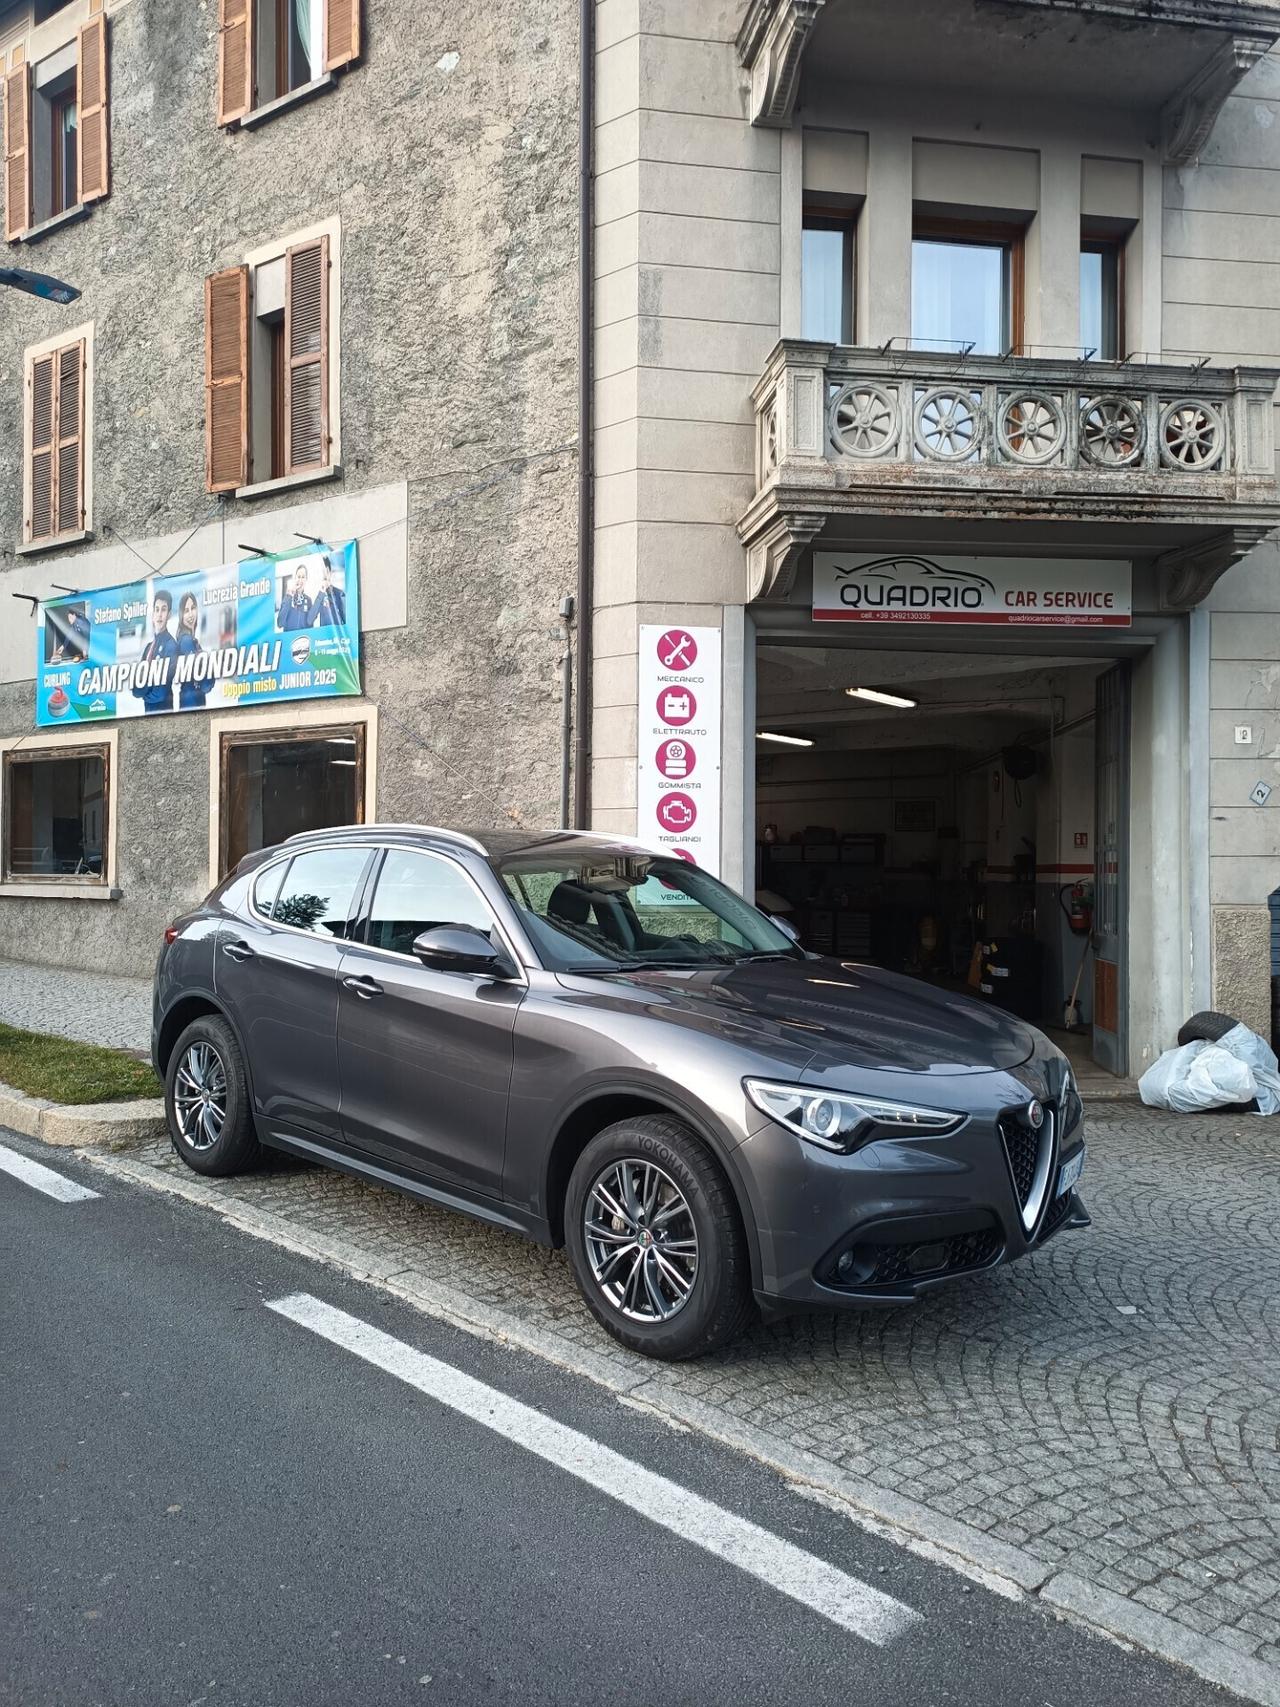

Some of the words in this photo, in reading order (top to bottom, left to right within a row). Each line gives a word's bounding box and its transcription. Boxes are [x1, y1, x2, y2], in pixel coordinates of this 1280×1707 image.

[202, 583, 238, 604] Lucrezia
[240, 577, 271, 599] Grande
[840, 584, 982, 608] QUADRIO
[1004, 591, 1037, 607] CAR
[1043, 591, 1114, 608] SERVICE
[94, 607, 121, 625] Stefano
[1008, 613, 1103, 624] quadriocarservice@gmail.com
[78, 656, 171, 696] CAMPIONI
[174, 640, 283, 684] MONDIALI
[223, 679, 251, 698] Doppio
[253, 675, 277, 692] misto
[280, 670, 311, 690] JUNIOR
[314, 668, 337, 686] 2025
[657, 675, 705, 684] MECCANICO
[652, 727, 707, 736] ELETTRAUTO
[658, 781, 702, 789] GOMMISTA
[1256, 789, 1266, 798] 2
[658, 835, 702, 843] TAGLIANDI
[660, 893, 693, 901] VENDIT
[637, 1135, 700, 1199] YOKOHAMA
